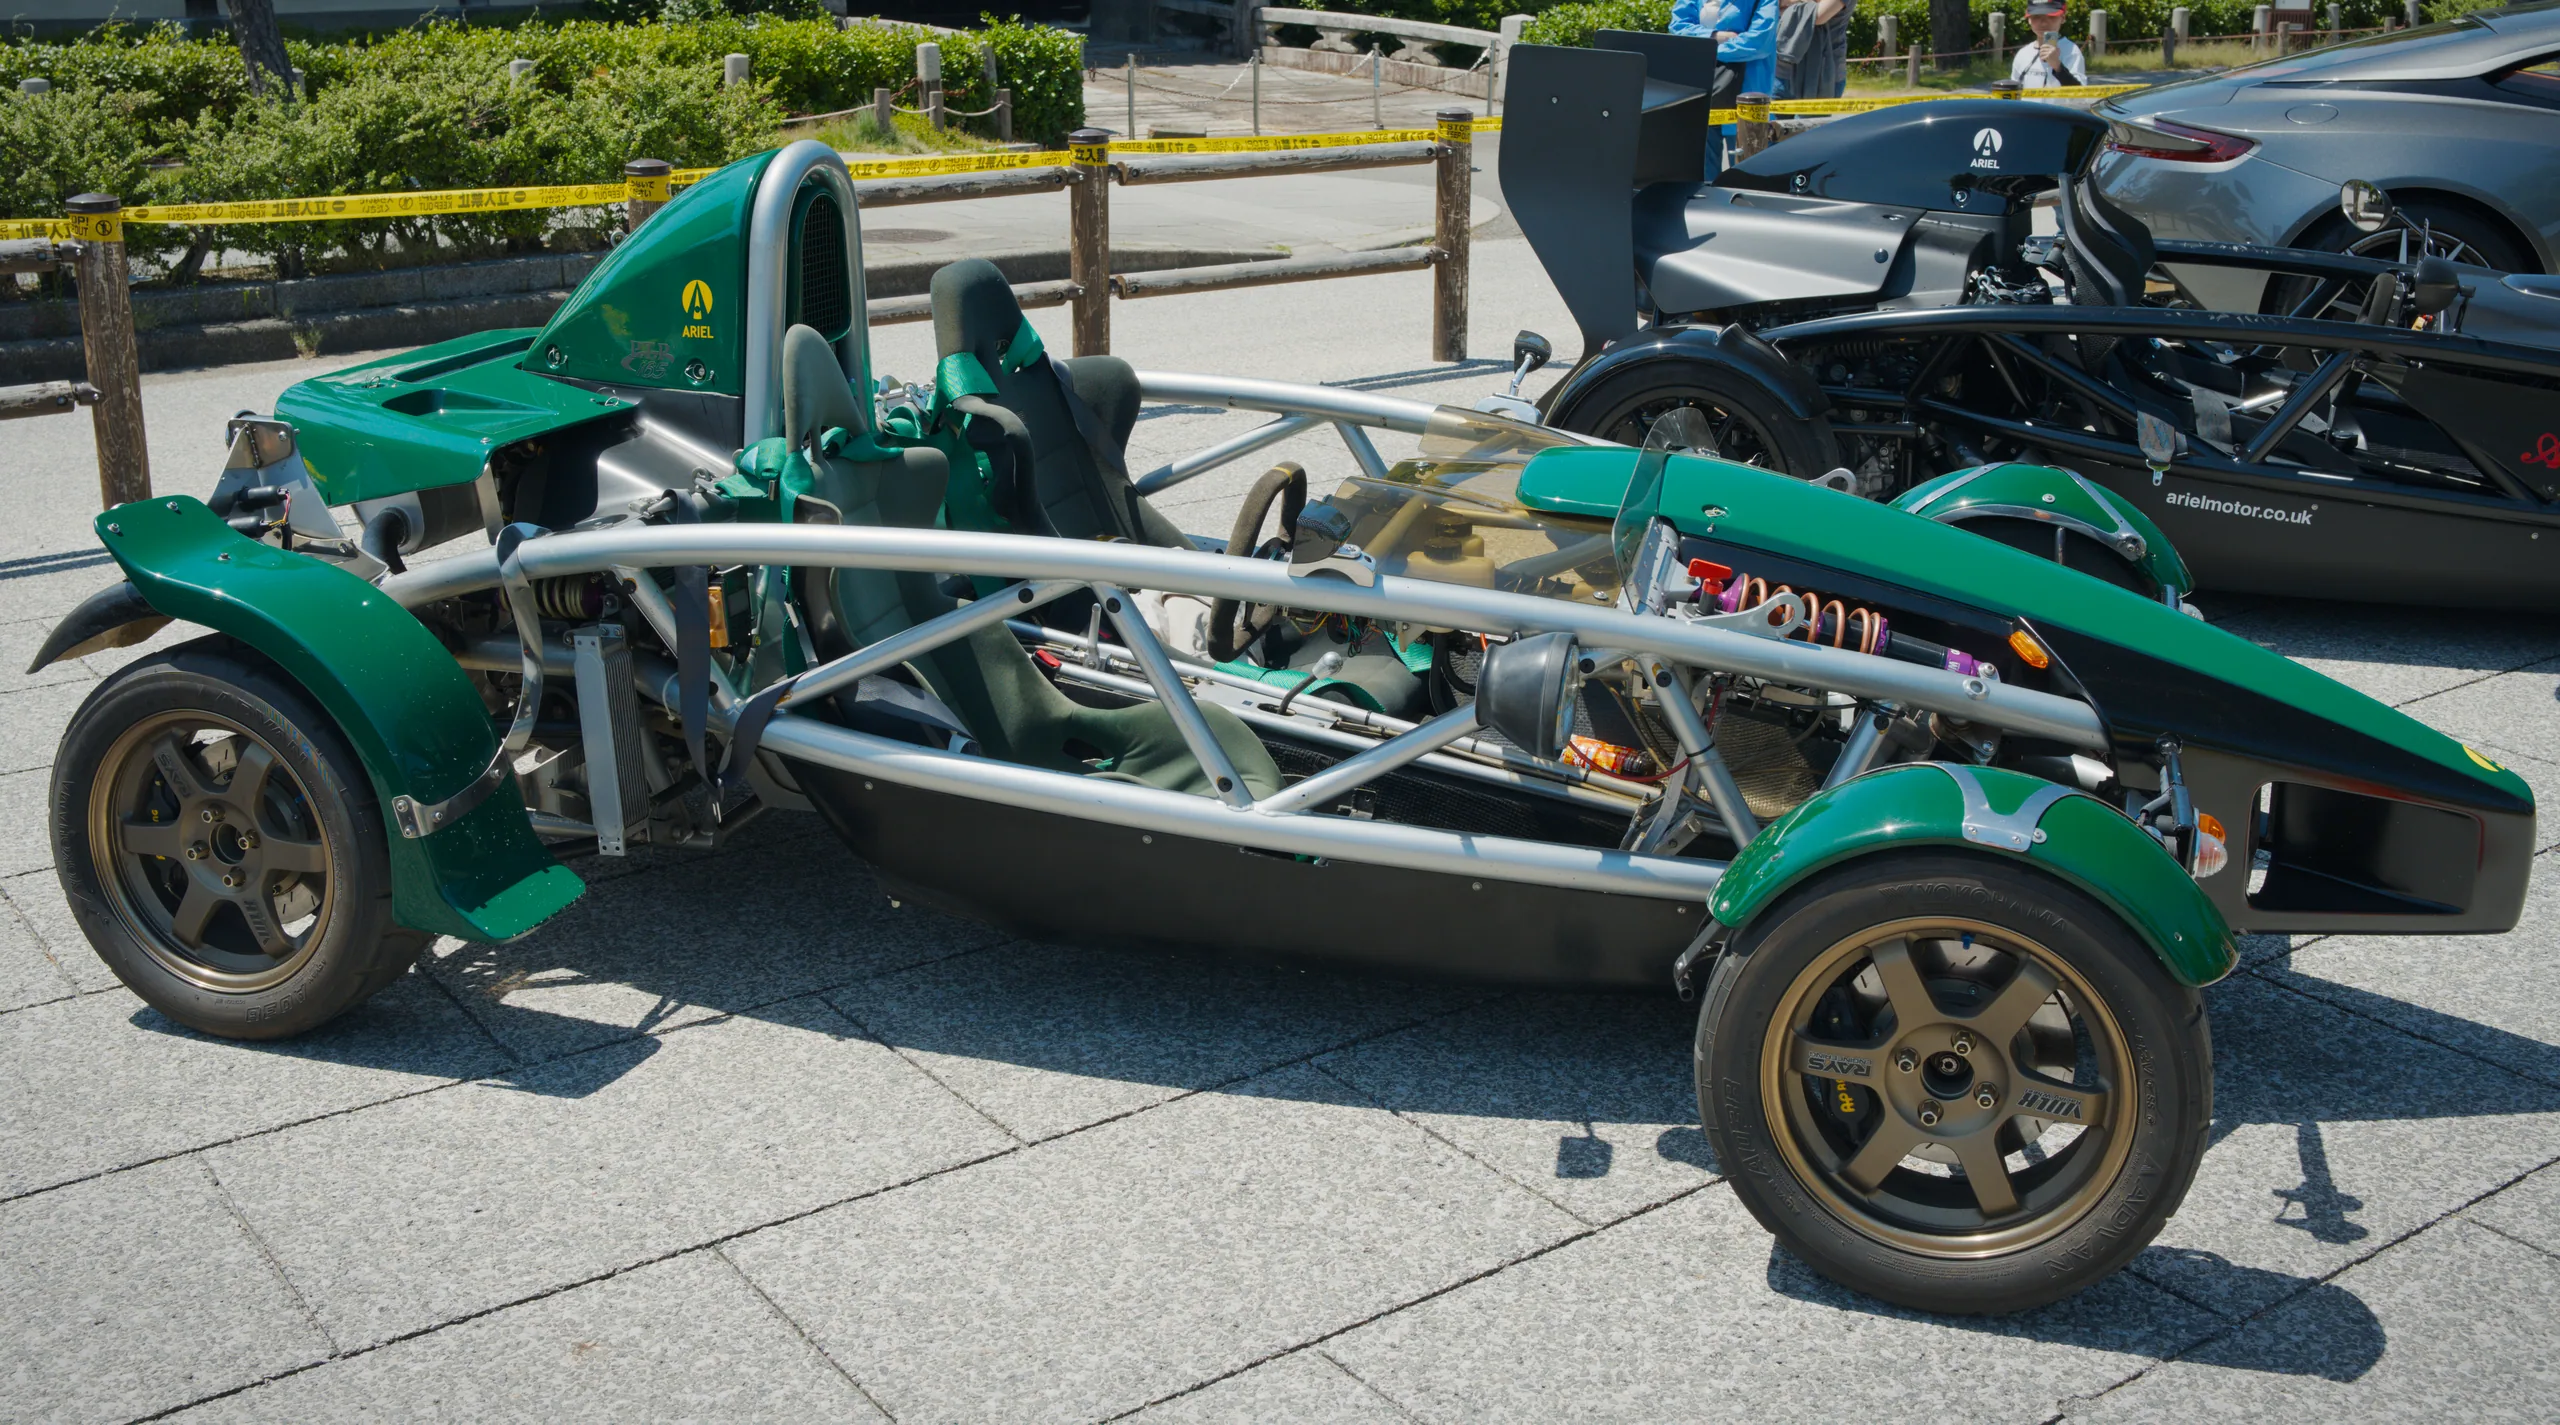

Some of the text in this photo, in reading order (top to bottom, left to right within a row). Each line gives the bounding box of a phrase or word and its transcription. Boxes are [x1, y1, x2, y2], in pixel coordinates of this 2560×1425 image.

[1075, 147, 1106, 163] 立入禁
[1970, 158, 2000, 169] ARIEL
[682, 325, 714, 339] ARIEL
[2166, 490, 2312, 525] arielmotor.co.uk
[1807, 1057, 1872, 1078] RAYS
[1838, 1092, 1856, 1113] AP
